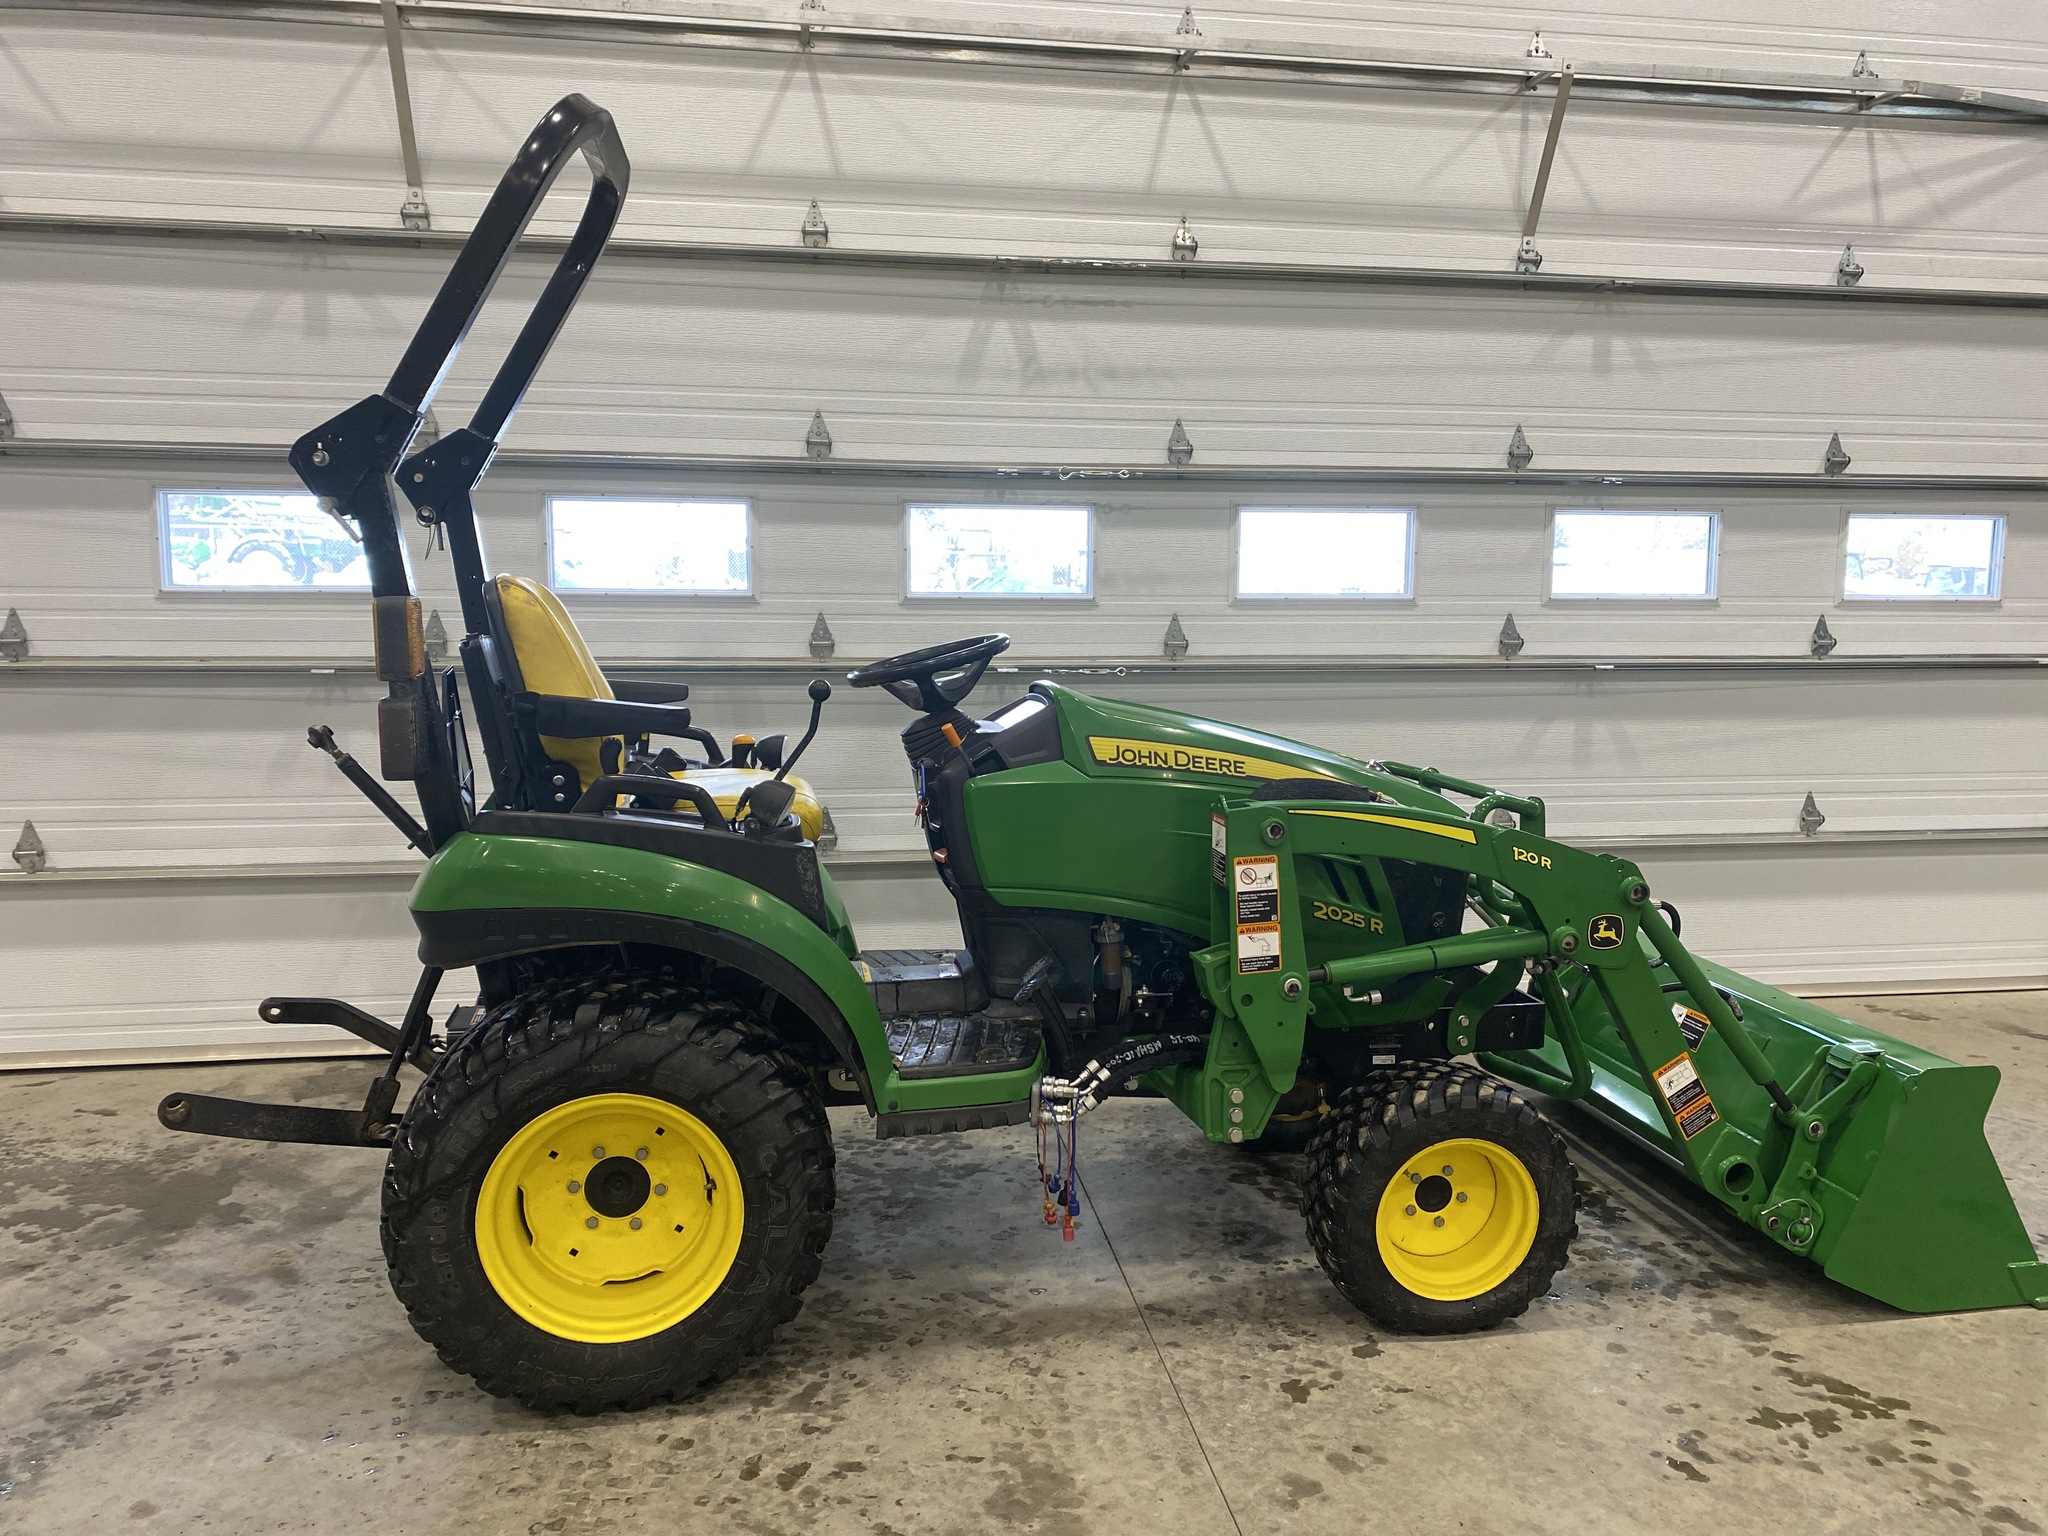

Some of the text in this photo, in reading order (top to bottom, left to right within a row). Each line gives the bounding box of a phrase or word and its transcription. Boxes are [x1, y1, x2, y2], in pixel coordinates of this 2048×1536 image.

[1108, 744, 1246, 775] JOHN DEERE
[1242, 855, 1276, 865] WARNING
[1512, 846, 1552, 870] 120 R
[1245, 924, 1278, 934] WARNING
[1312, 901, 1384, 935] 2025 R
